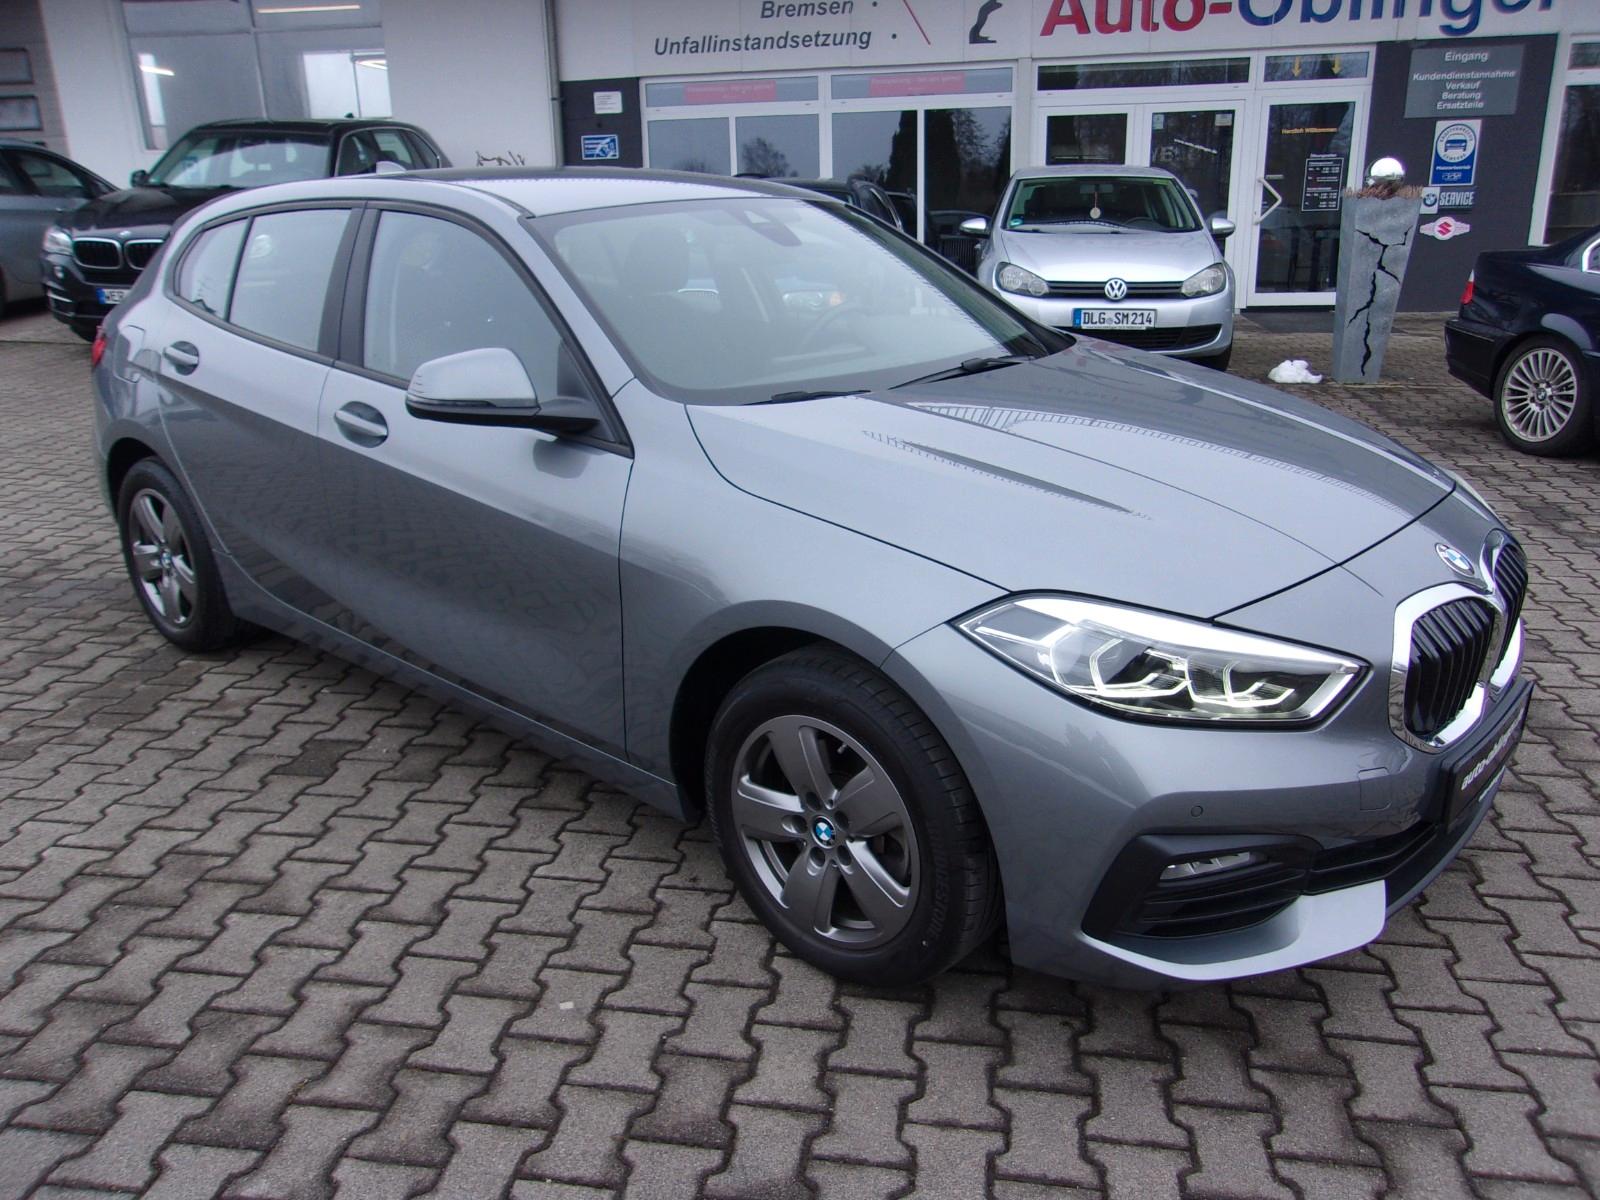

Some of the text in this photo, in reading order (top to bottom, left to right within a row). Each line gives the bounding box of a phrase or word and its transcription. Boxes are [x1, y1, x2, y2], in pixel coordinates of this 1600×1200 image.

[760, 0, 853, 19] Bremsen
[654, 30, 872, 56] Unfallinstandsetzung
[1445, 51, 1489, 63] Eingang
[1412, 70, 1516, 81] Kundendienstannahme
[1445, 81, 1482, 90] Verkauf
[1442, 92, 1482, 101] Beratung
[1436, 101, 1485, 110] Ersatzteile
[1439, 191, 1475, 206] SERVICE
[1083, 311, 1106, 325] DLG
[1461, 706, 1525, 791] auto-obl
